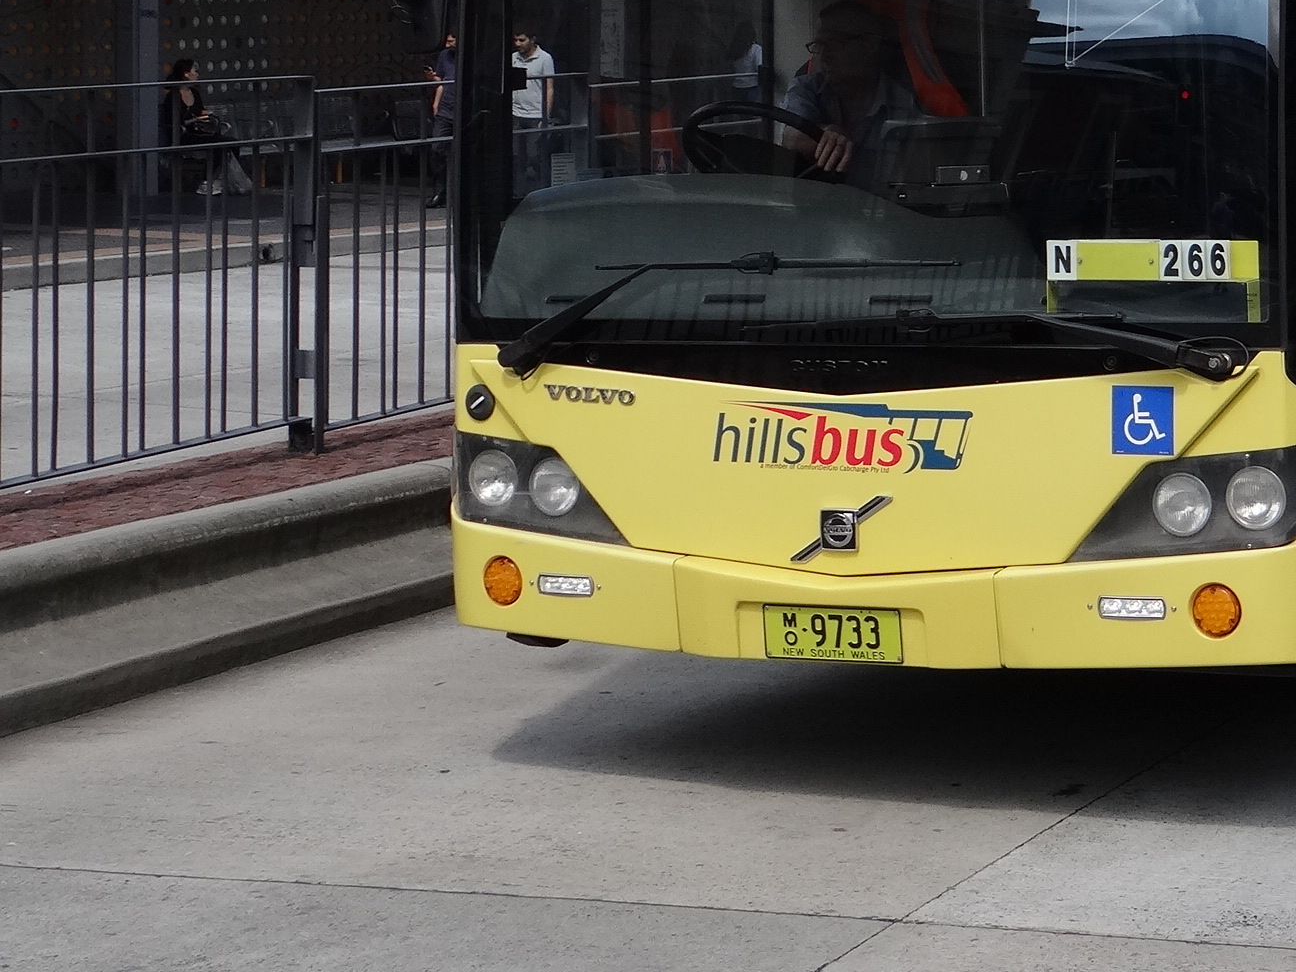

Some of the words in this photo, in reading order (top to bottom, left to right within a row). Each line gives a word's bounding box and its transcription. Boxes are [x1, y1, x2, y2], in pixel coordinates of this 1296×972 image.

[1054, 245, 1071, 274] N
[1163, 243, 1226, 277] 266
[543, 383, 636, 407] VOLVO
[712, 412, 905, 467] hillsbus
[839, 464, 869, 474] Cabcharge
[810, 613, 881, 650] 9733
[783, 648, 804, 657] NEW
[811, 648, 845, 659] SOUTH
[851, 651, 885, 661] WALES
